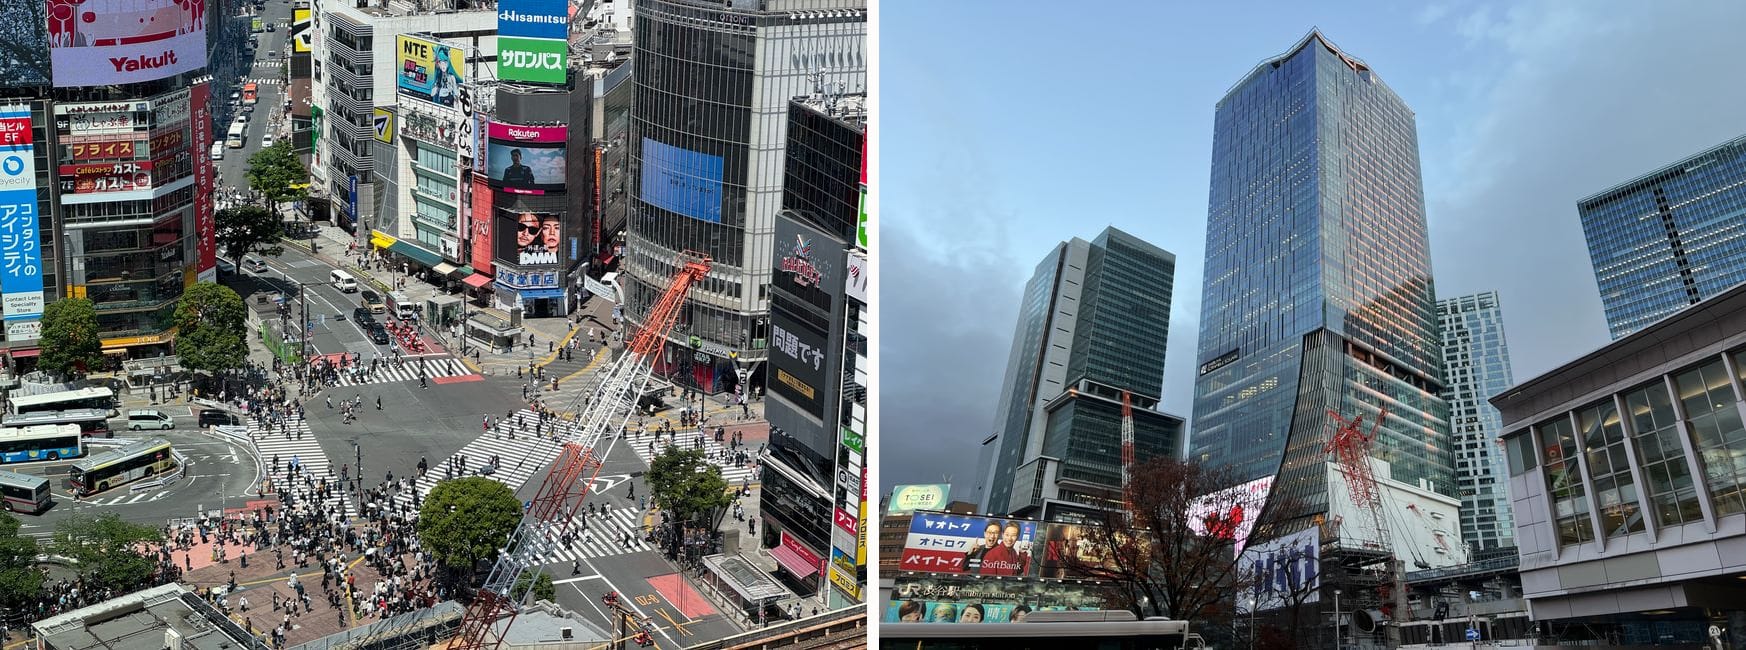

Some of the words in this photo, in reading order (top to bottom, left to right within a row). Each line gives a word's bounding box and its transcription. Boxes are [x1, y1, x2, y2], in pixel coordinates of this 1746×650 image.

[498, 9, 567, 24] Hisamitsu
[404, 40, 427, 59] NTE
[110, 50, 178, 72] Yakult
[501, 49, 562, 71] サロンパス
[57, 120, 69, 129] 9F
[4, 132, 19, 142] 5F
[508, 128, 540, 138] Rakuten
[61, 181, 74, 190] 7F
[0, 203, 21, 277] アイシティ
[20, 203, 37, 276] コンタクトの
[520, 252, 558, 265] DMM
[772, 324, 824, 371] 問題です
[919, 538, 967, 548] オドロク
[905, 555, 964, 567] ペイトク
[982, 560, 1021, 570] SoftBank
[835, 573, 855, 592] プロミス
[898, 582, 920, 596] JR
[923, 584, 961, 597] 渋谷駅
